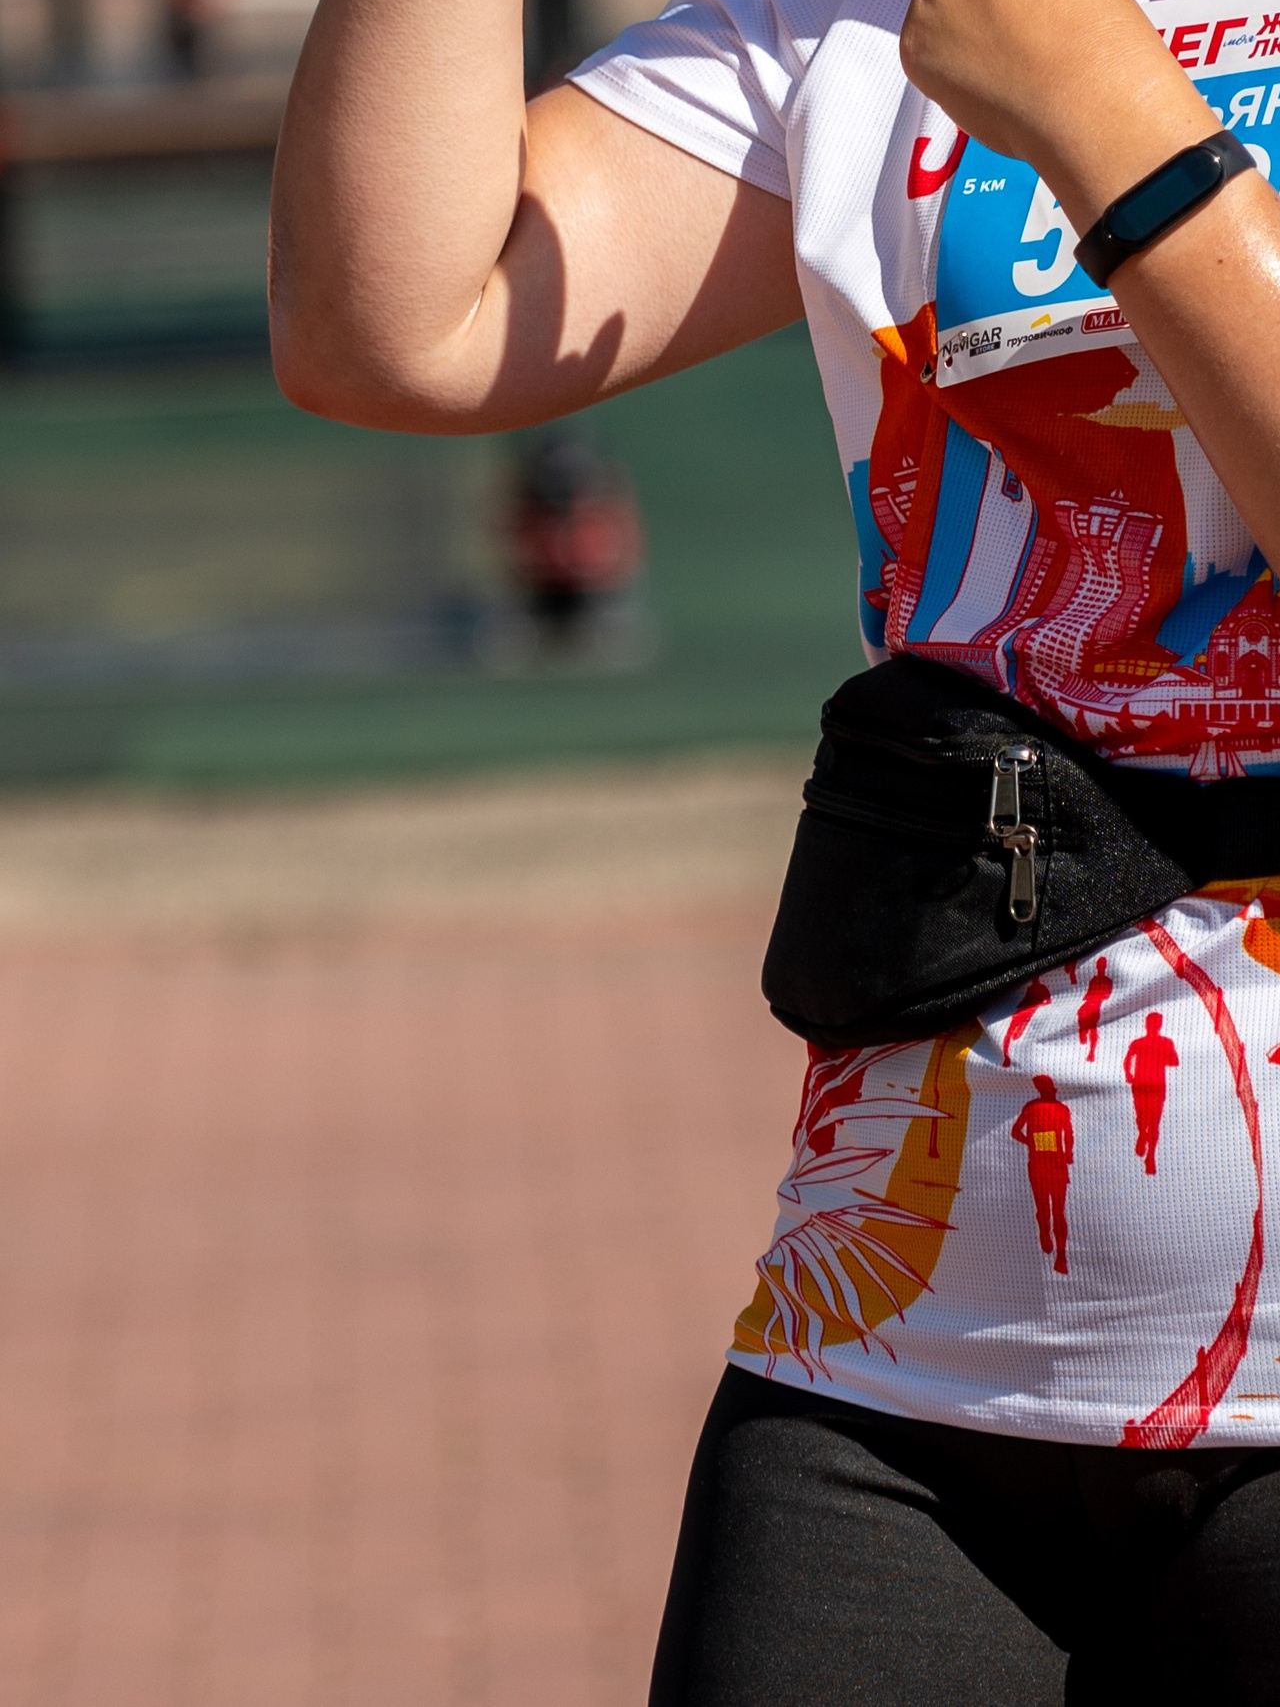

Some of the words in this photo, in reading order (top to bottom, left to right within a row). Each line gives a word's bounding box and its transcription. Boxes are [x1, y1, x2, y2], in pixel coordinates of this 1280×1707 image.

[1156, 16, 1249, 69] ЕГ
[963, 179, 975, 195] 5
[1006, 326, 1074, 348] грузовичкоф
